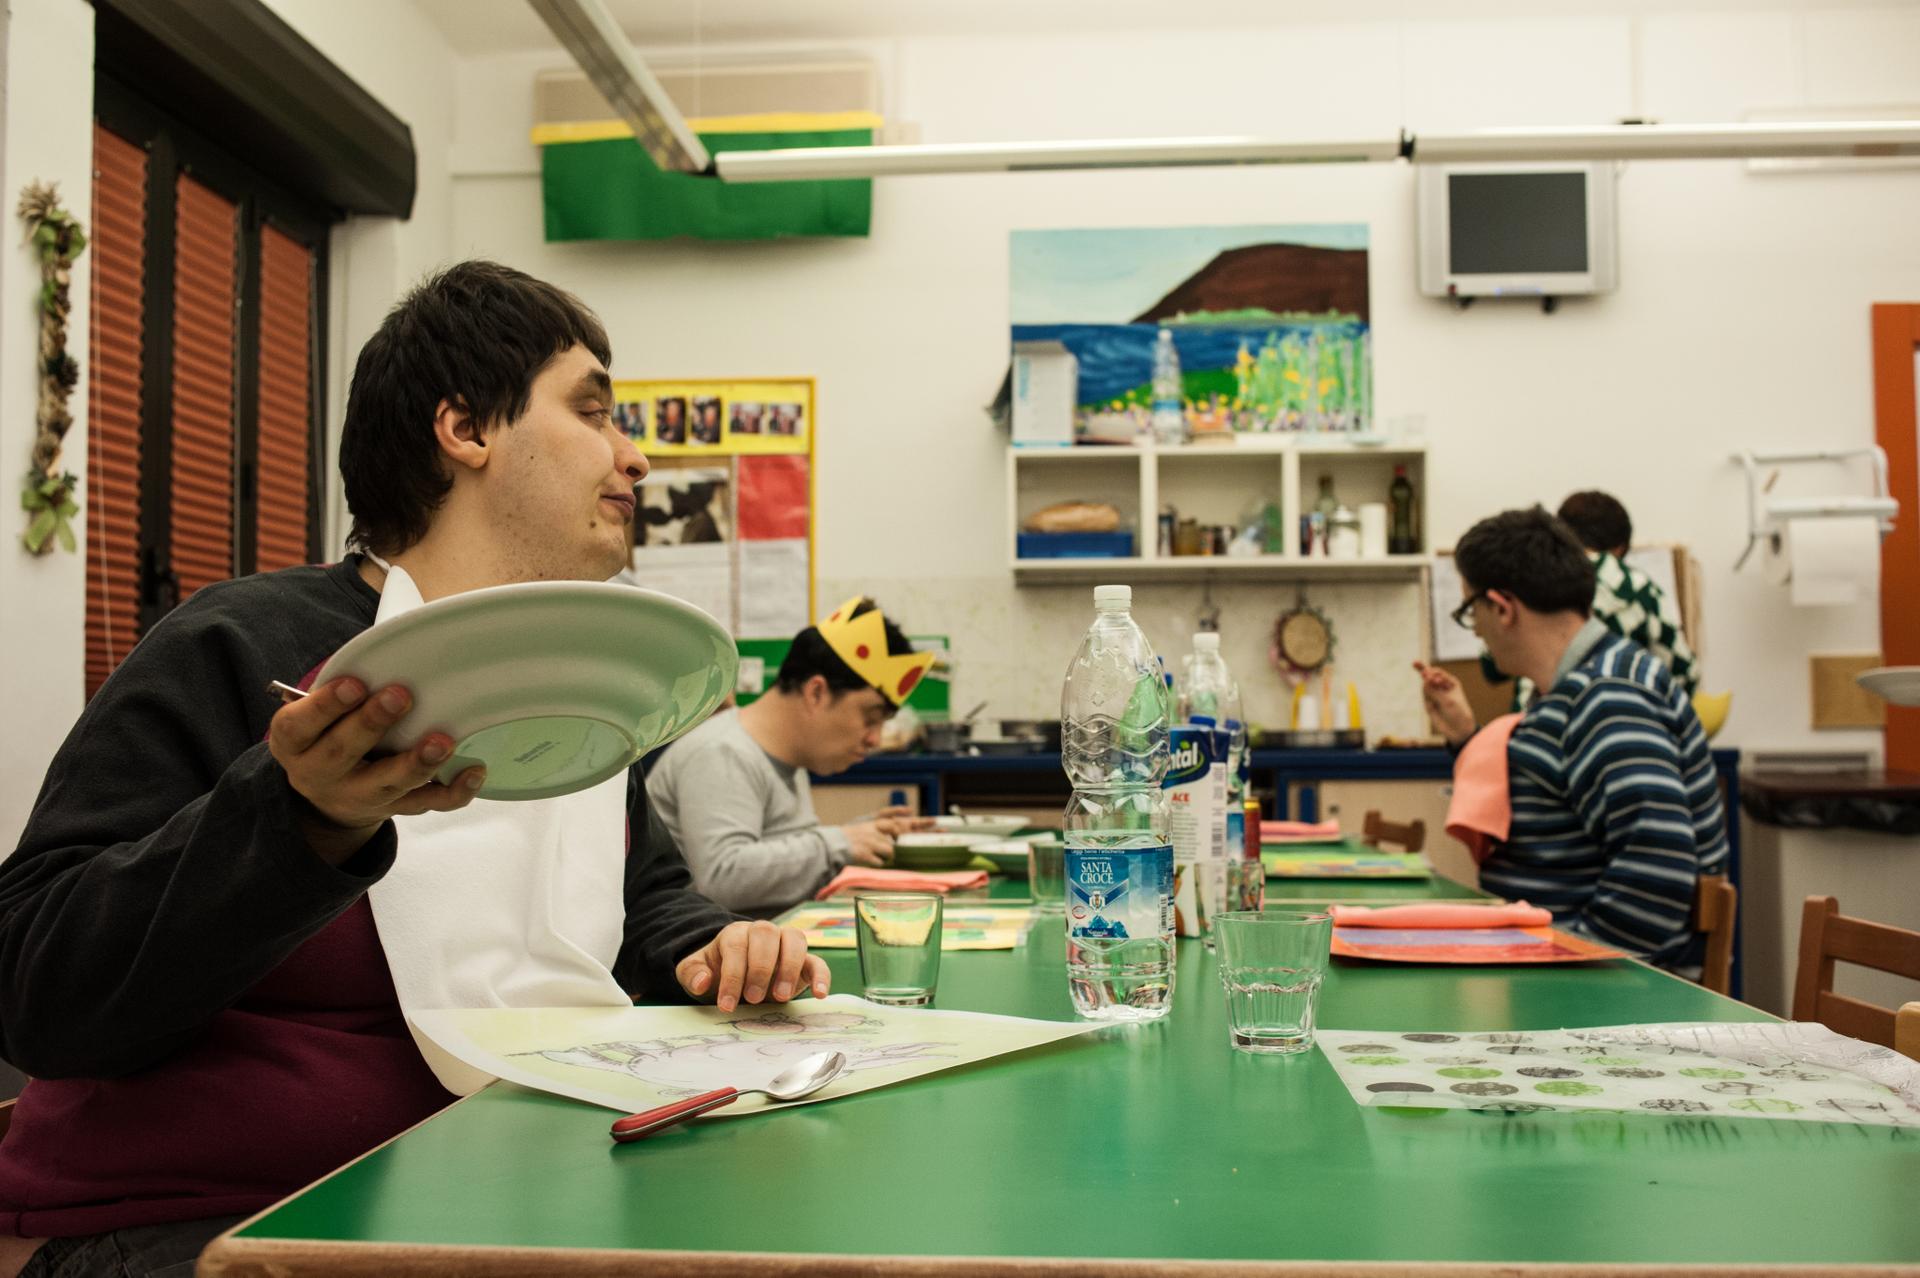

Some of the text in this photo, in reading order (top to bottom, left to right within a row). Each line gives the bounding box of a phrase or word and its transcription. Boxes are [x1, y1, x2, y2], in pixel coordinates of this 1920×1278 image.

[1171, 792, 1190, 803] ACE
[1081, 861, 1112, 873] SANTA
[1080, 873, 1114, 884] CROCE
